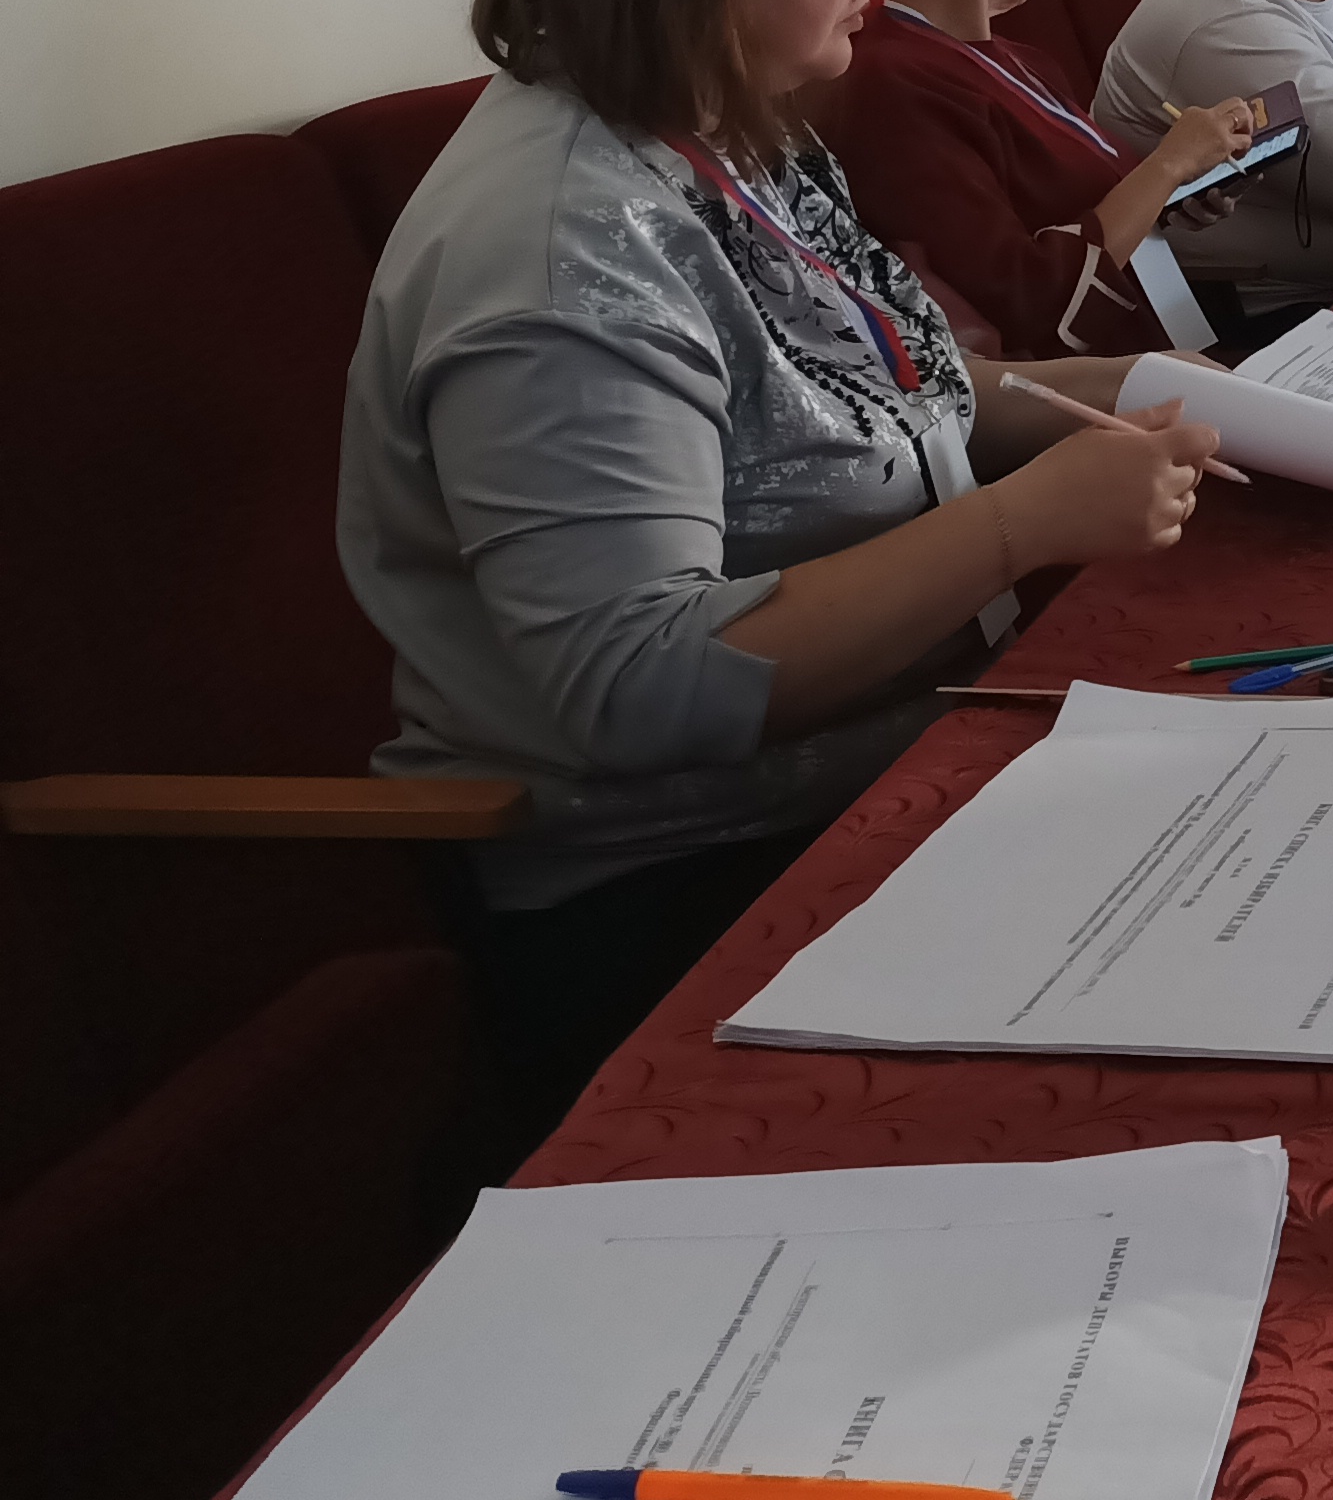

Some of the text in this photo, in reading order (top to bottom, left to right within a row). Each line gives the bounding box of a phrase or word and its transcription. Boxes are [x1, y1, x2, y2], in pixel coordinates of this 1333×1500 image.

[1213, 871, 1282, 942] ИЗБИРАТЕЛЕЙ
[1098, 1236, 1131, 1302] ВЫБОРЫ
[1067, 1305, 1109, 1380] ДЕПУТАТОВ
[831, 1395, 886, 1465] КНИГА
